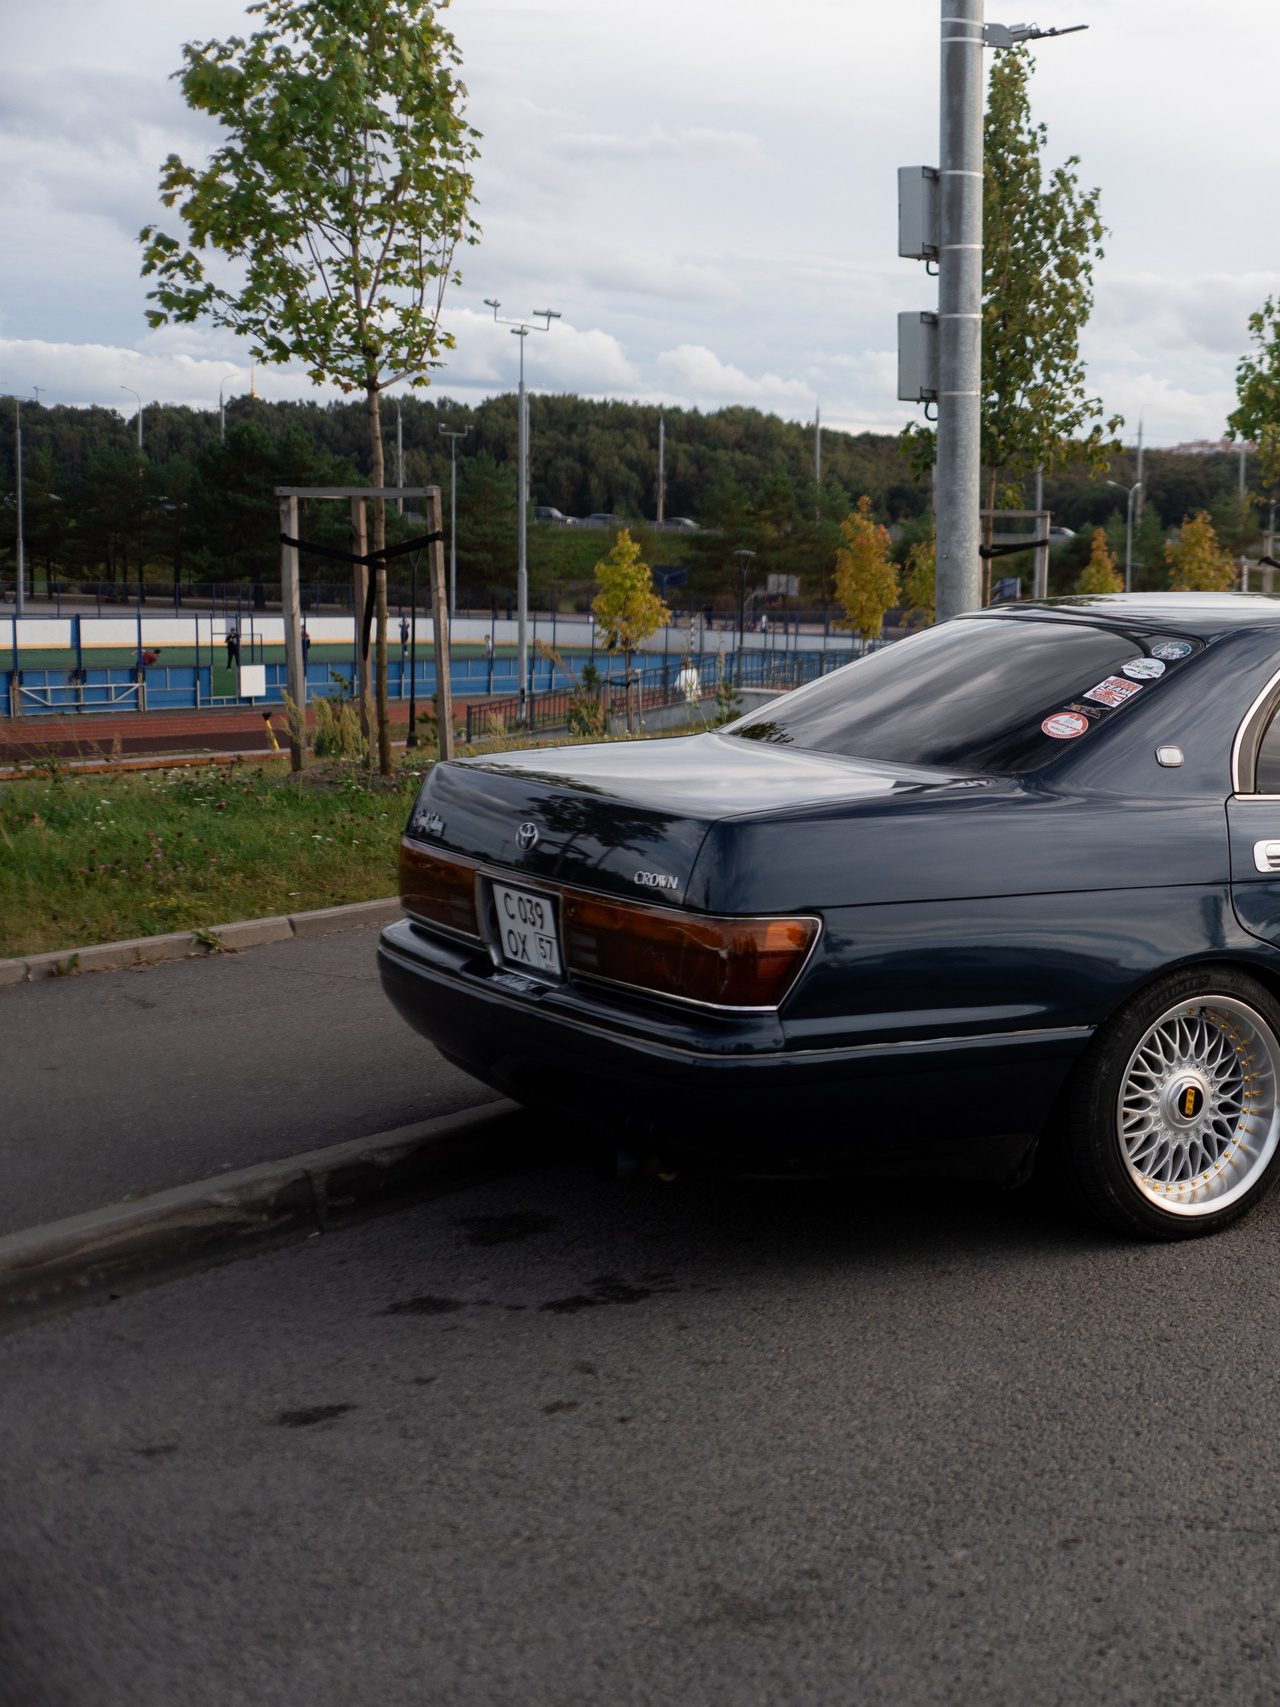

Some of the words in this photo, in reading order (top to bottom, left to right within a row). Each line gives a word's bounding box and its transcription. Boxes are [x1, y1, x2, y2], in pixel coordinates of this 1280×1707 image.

[1103, 683, 1132, 696] TEAM
[1106, 678, 1139, 692] JDM
[634, 870, 679, 889] CROWN
[517, 896, 544, 930] 039
[538, 937, 553, 961] 57
